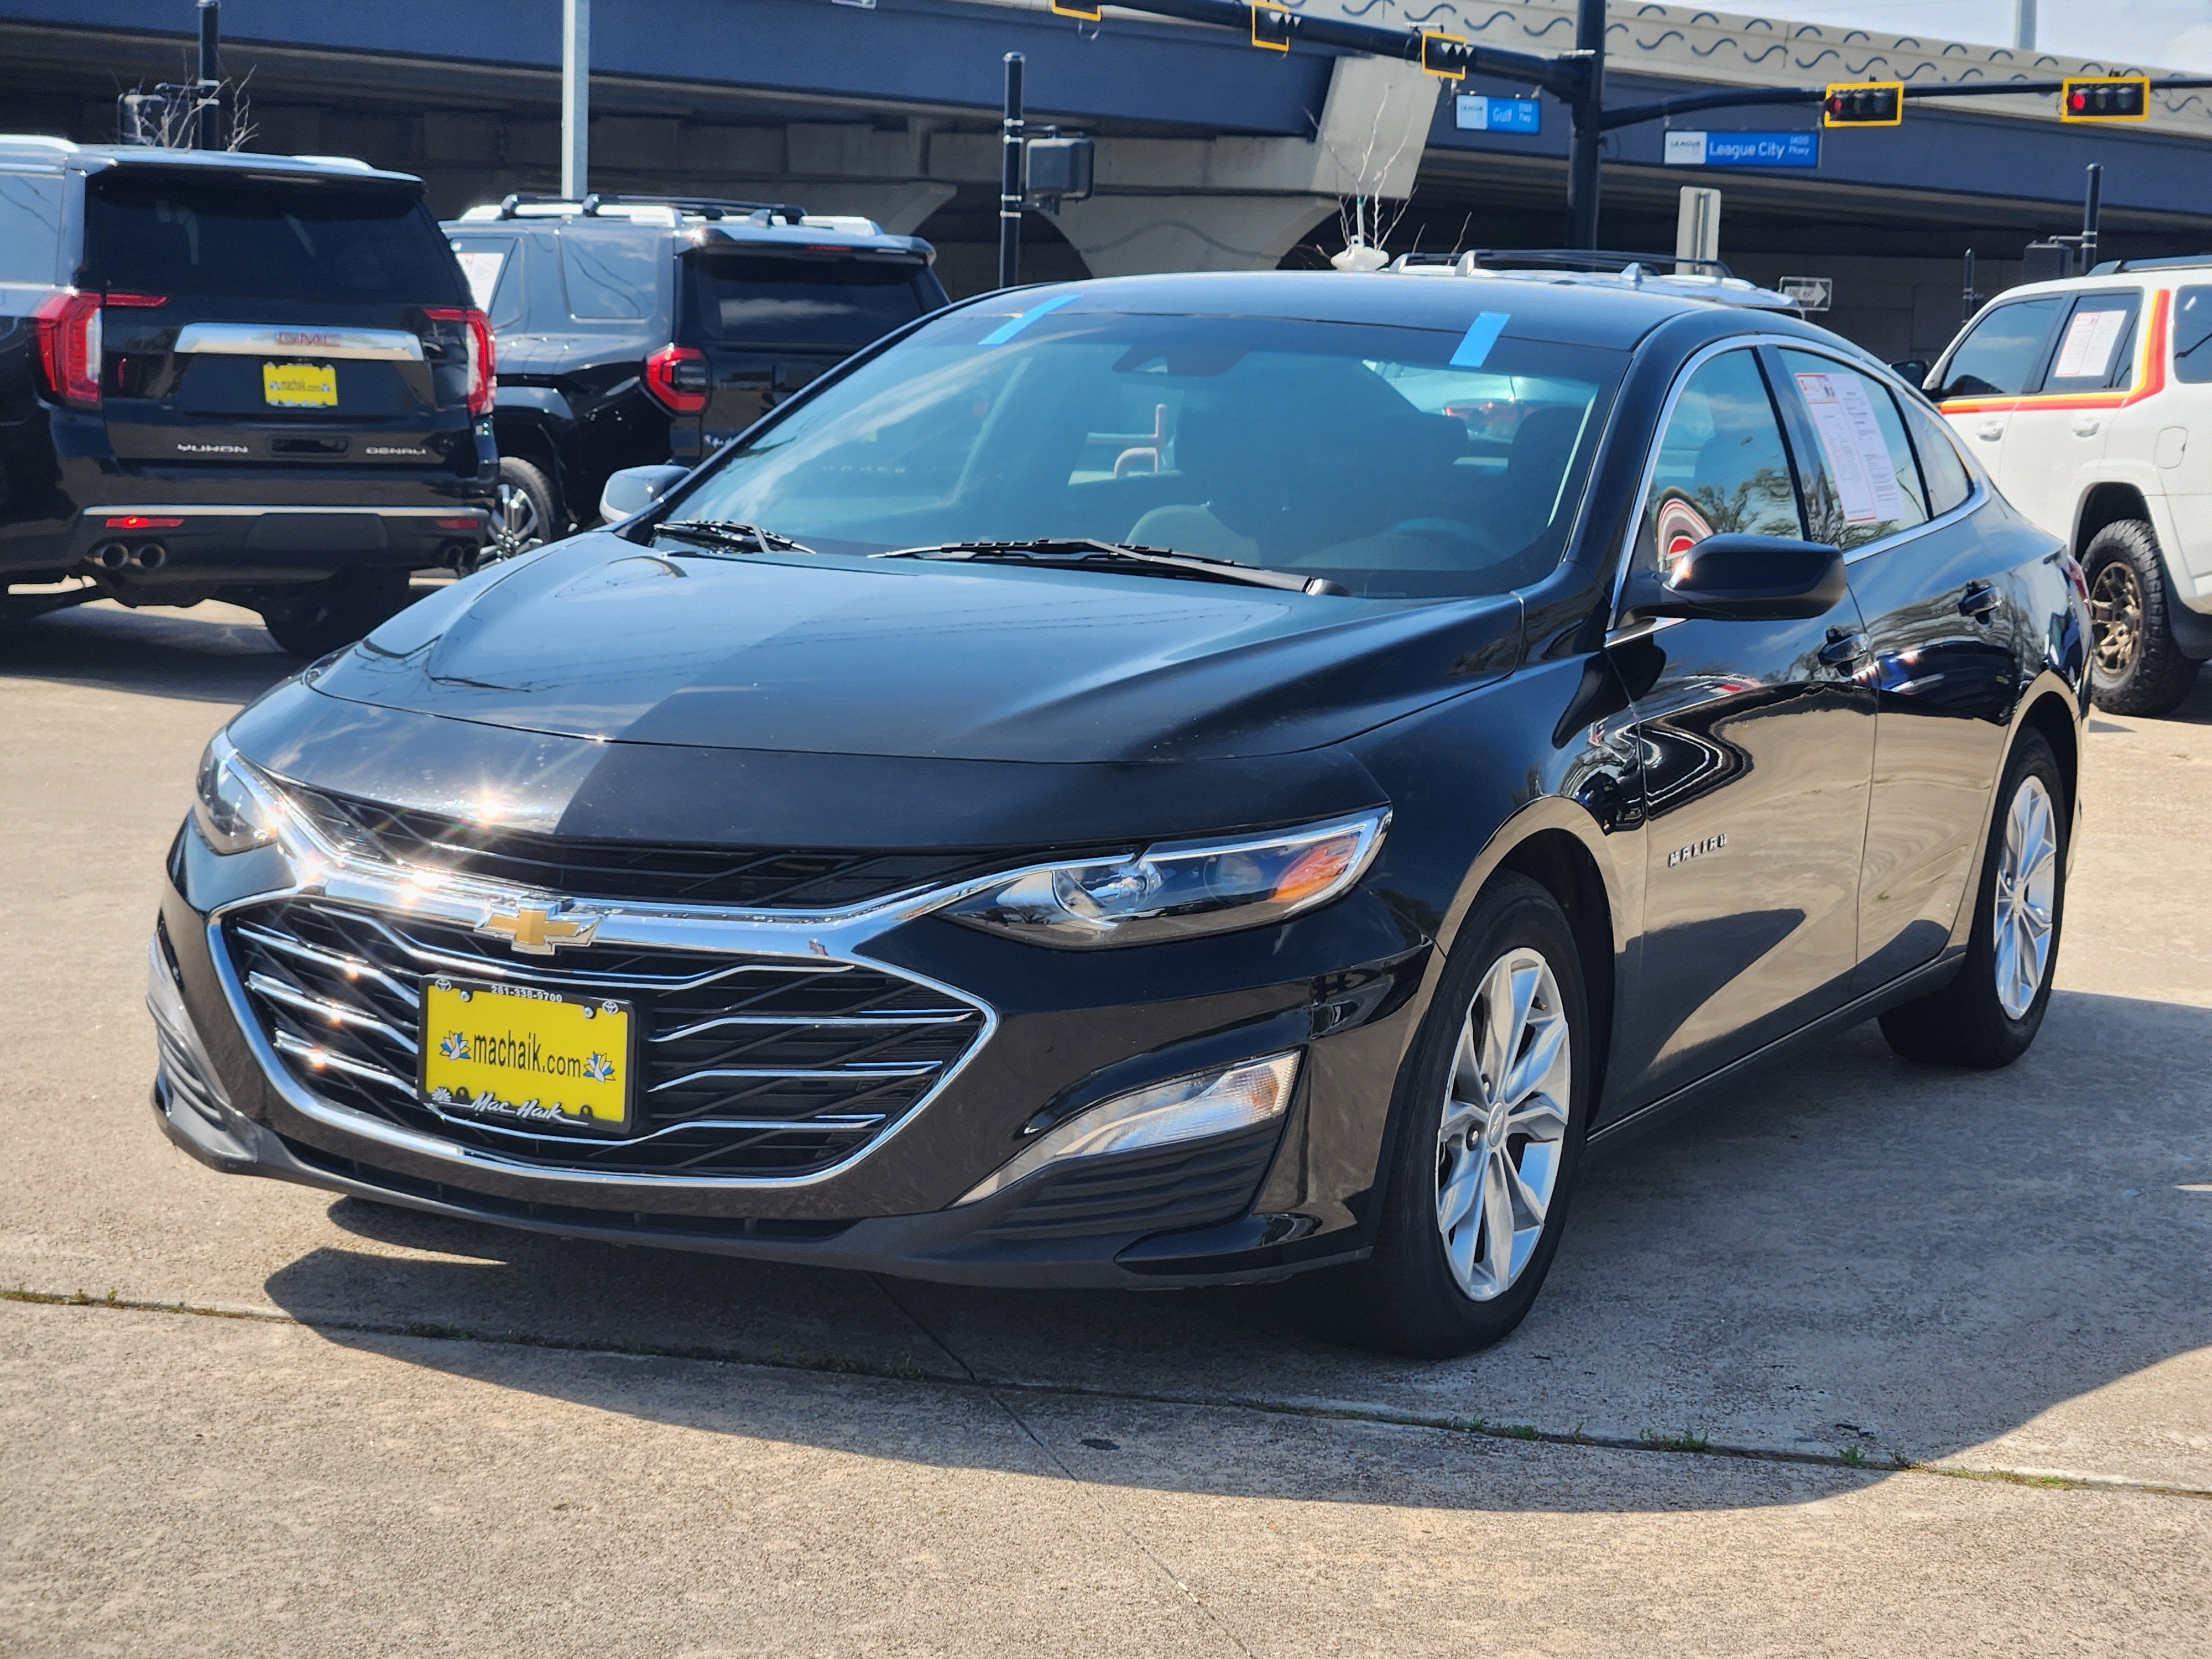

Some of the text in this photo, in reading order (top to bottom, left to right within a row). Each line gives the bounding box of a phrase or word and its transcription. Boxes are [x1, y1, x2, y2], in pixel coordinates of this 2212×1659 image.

[1709, 142, 1786, 160] League City
[277, 332, 341, 347] GMC
[177, 443, 427, 455] YUKON DENALI
[1668, 833, 1728, 868] MALIBU
[491, 985, 562, 1003] 281-338-9700
[473, 1030, 581, 1078] machaik.com
[471, 1091, 589, 1126] Mac Haik
